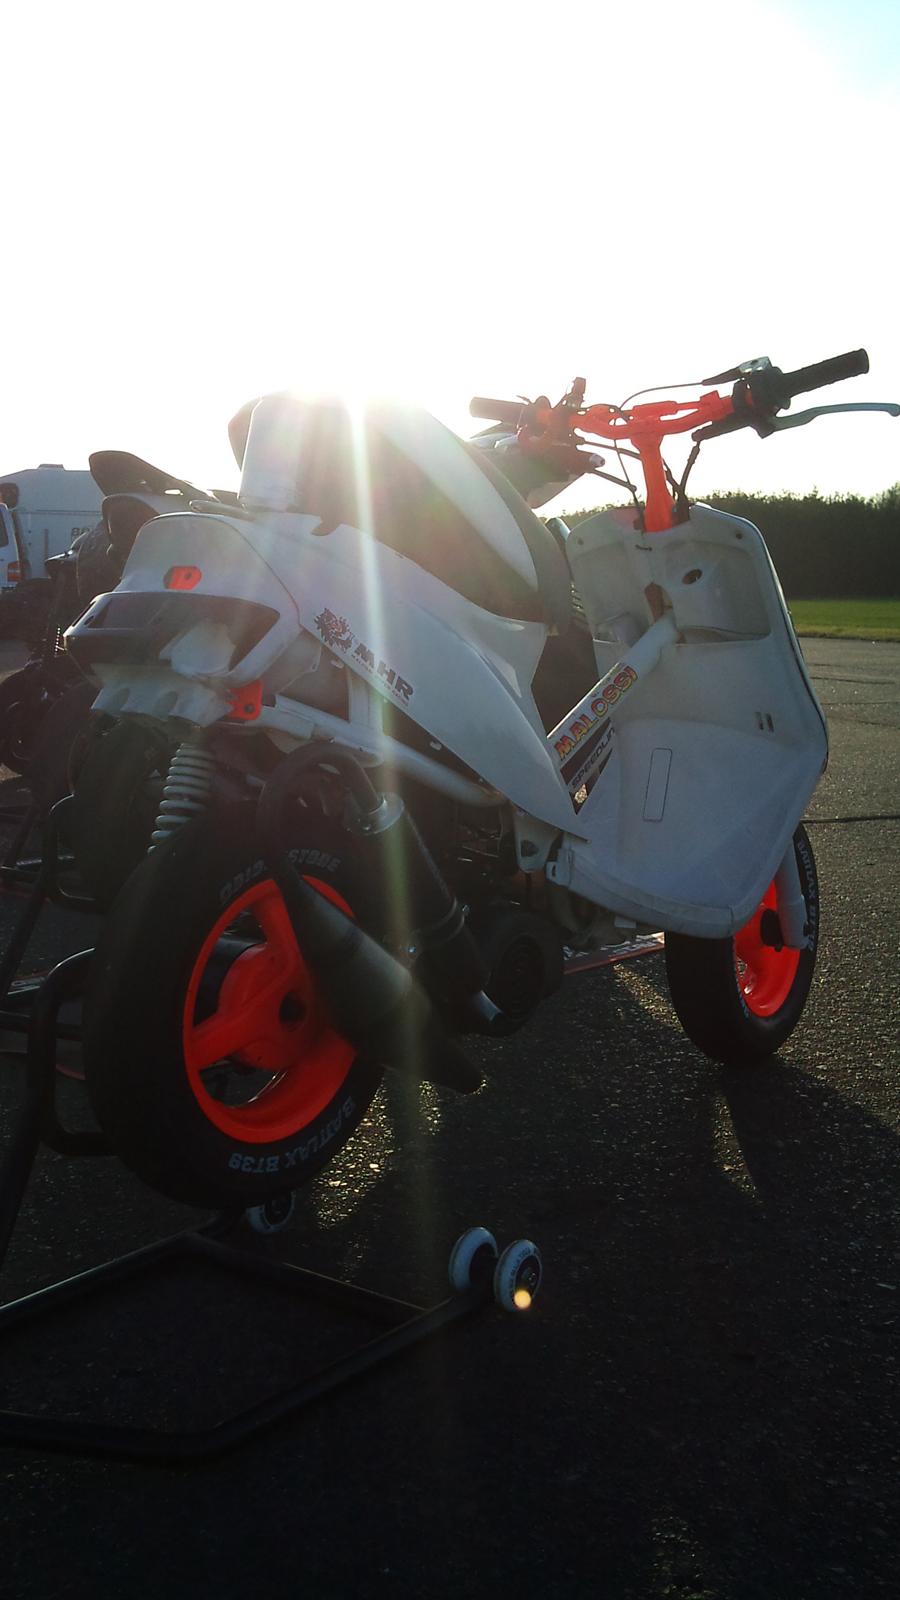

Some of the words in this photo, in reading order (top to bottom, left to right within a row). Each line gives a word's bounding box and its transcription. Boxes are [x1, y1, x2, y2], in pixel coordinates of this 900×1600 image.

[354, 642, 413, 700] MHR
[554, 666, 638, 761] MALOSSI
[228, 1152, 280, 1174] BT39
[285, 1096, 355, 1168] BATTLAX
